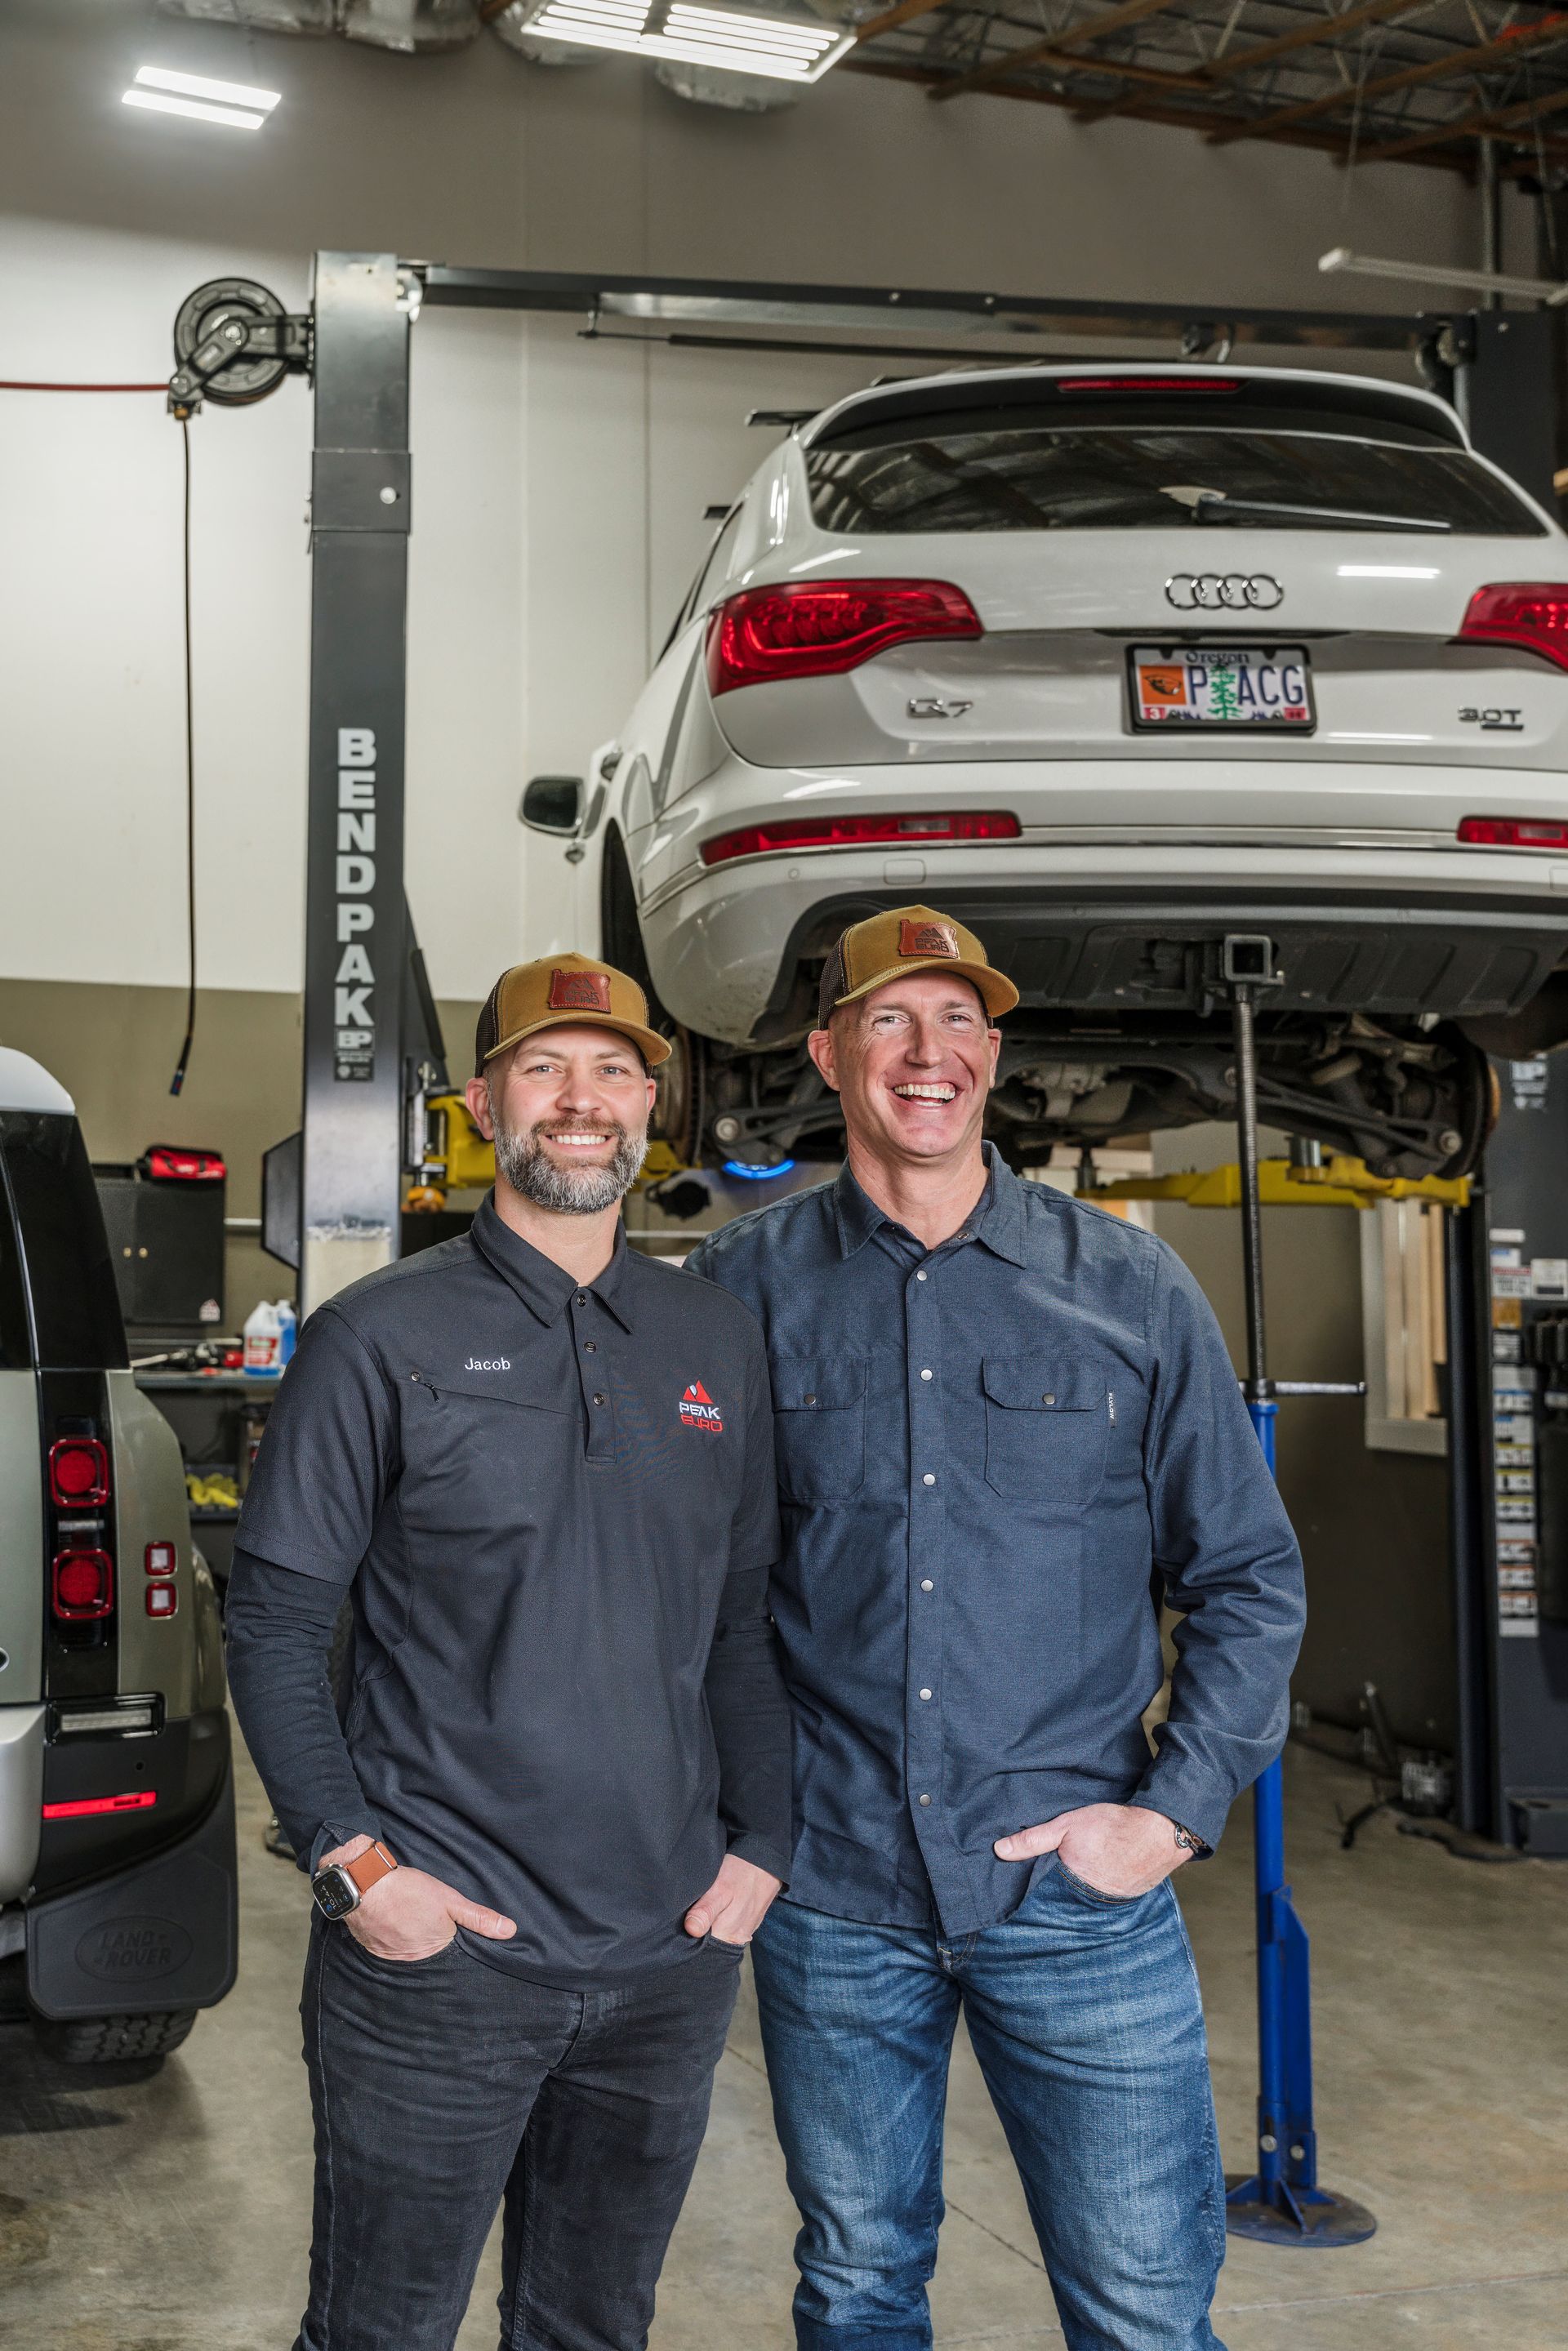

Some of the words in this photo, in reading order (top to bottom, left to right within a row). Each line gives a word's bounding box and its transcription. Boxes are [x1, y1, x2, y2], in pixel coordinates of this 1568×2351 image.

[1186, 650, 1250, 666] Oregon
[1188, 666, 1208, 706] P
[1238, 665, 1304, 706] ACG
[334, 728, 377, 1026] BENDPAK
[915, 937, 947, 946] PEAK
[338, 1030, 373, 1049] BP
[464, 1356, 511, 1370] Jacob
[679, 1401, 721, 1419] PEAK
[680, 1414, 724, 1432] EURO
